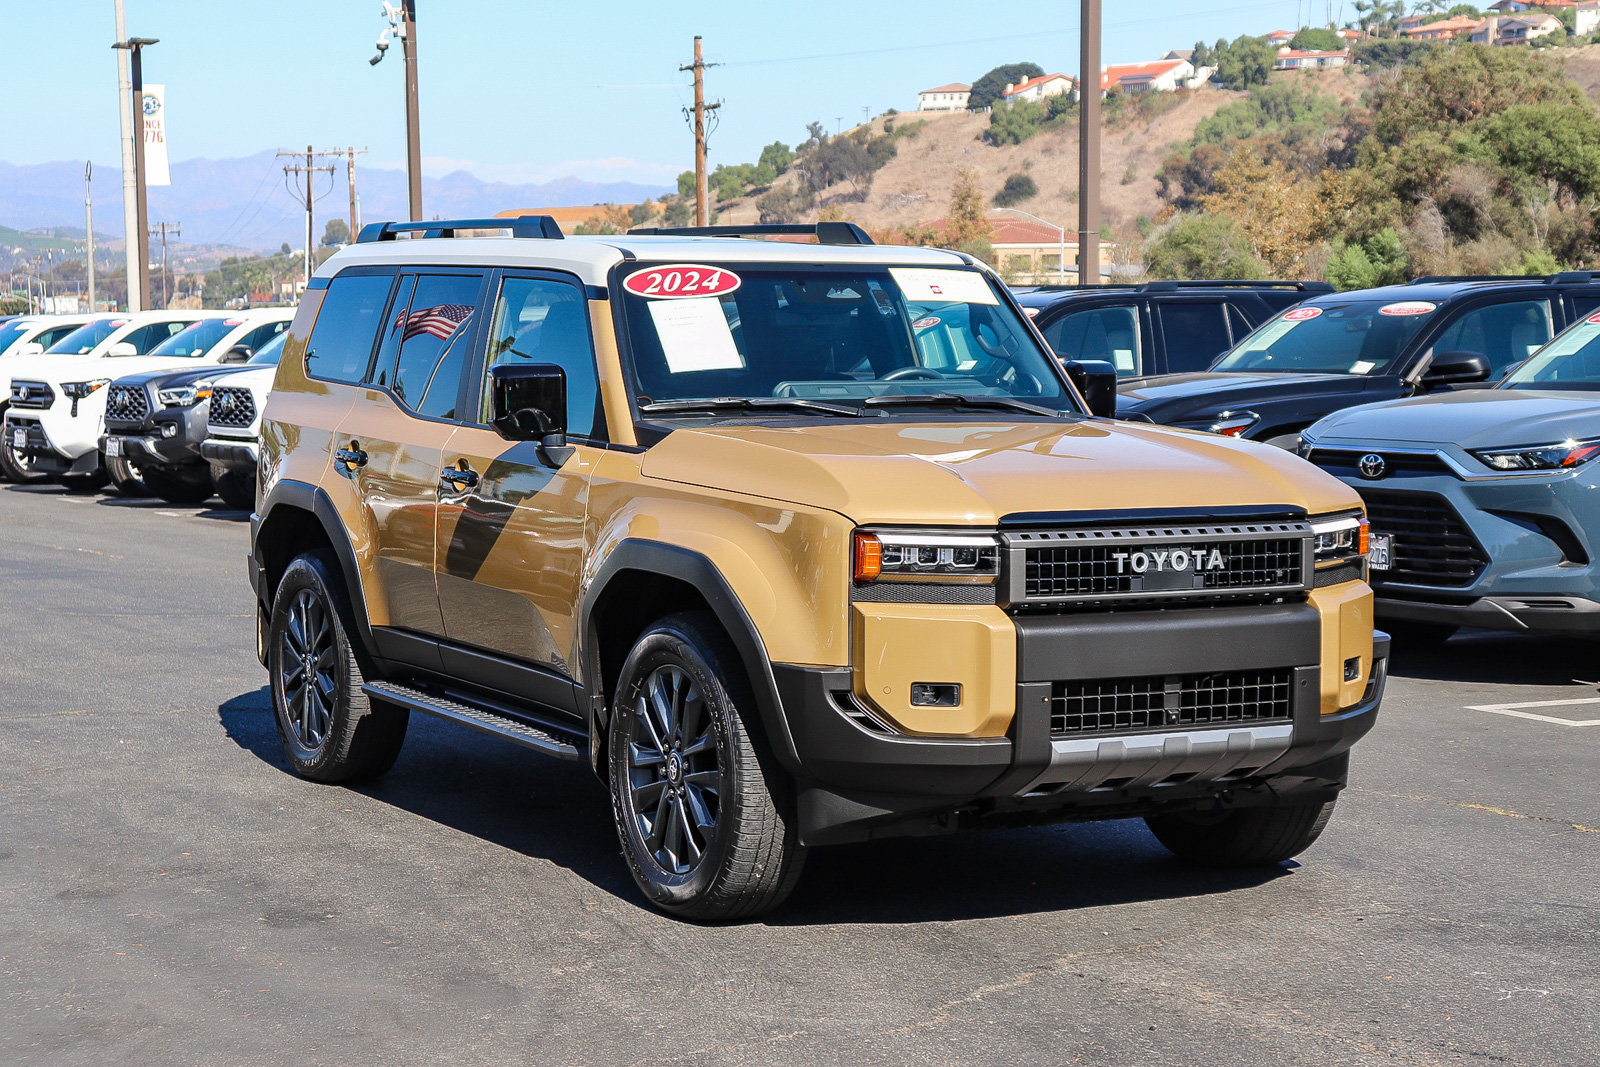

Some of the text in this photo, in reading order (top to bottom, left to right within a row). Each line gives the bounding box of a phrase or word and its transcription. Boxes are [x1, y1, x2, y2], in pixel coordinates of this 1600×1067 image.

[144, 130, 164, 143] 776
[643, 270, 722, 294] 2024
[1112, 549, 1226, 573] TOYOTA
[1369, 545, 1389, 564] 275
